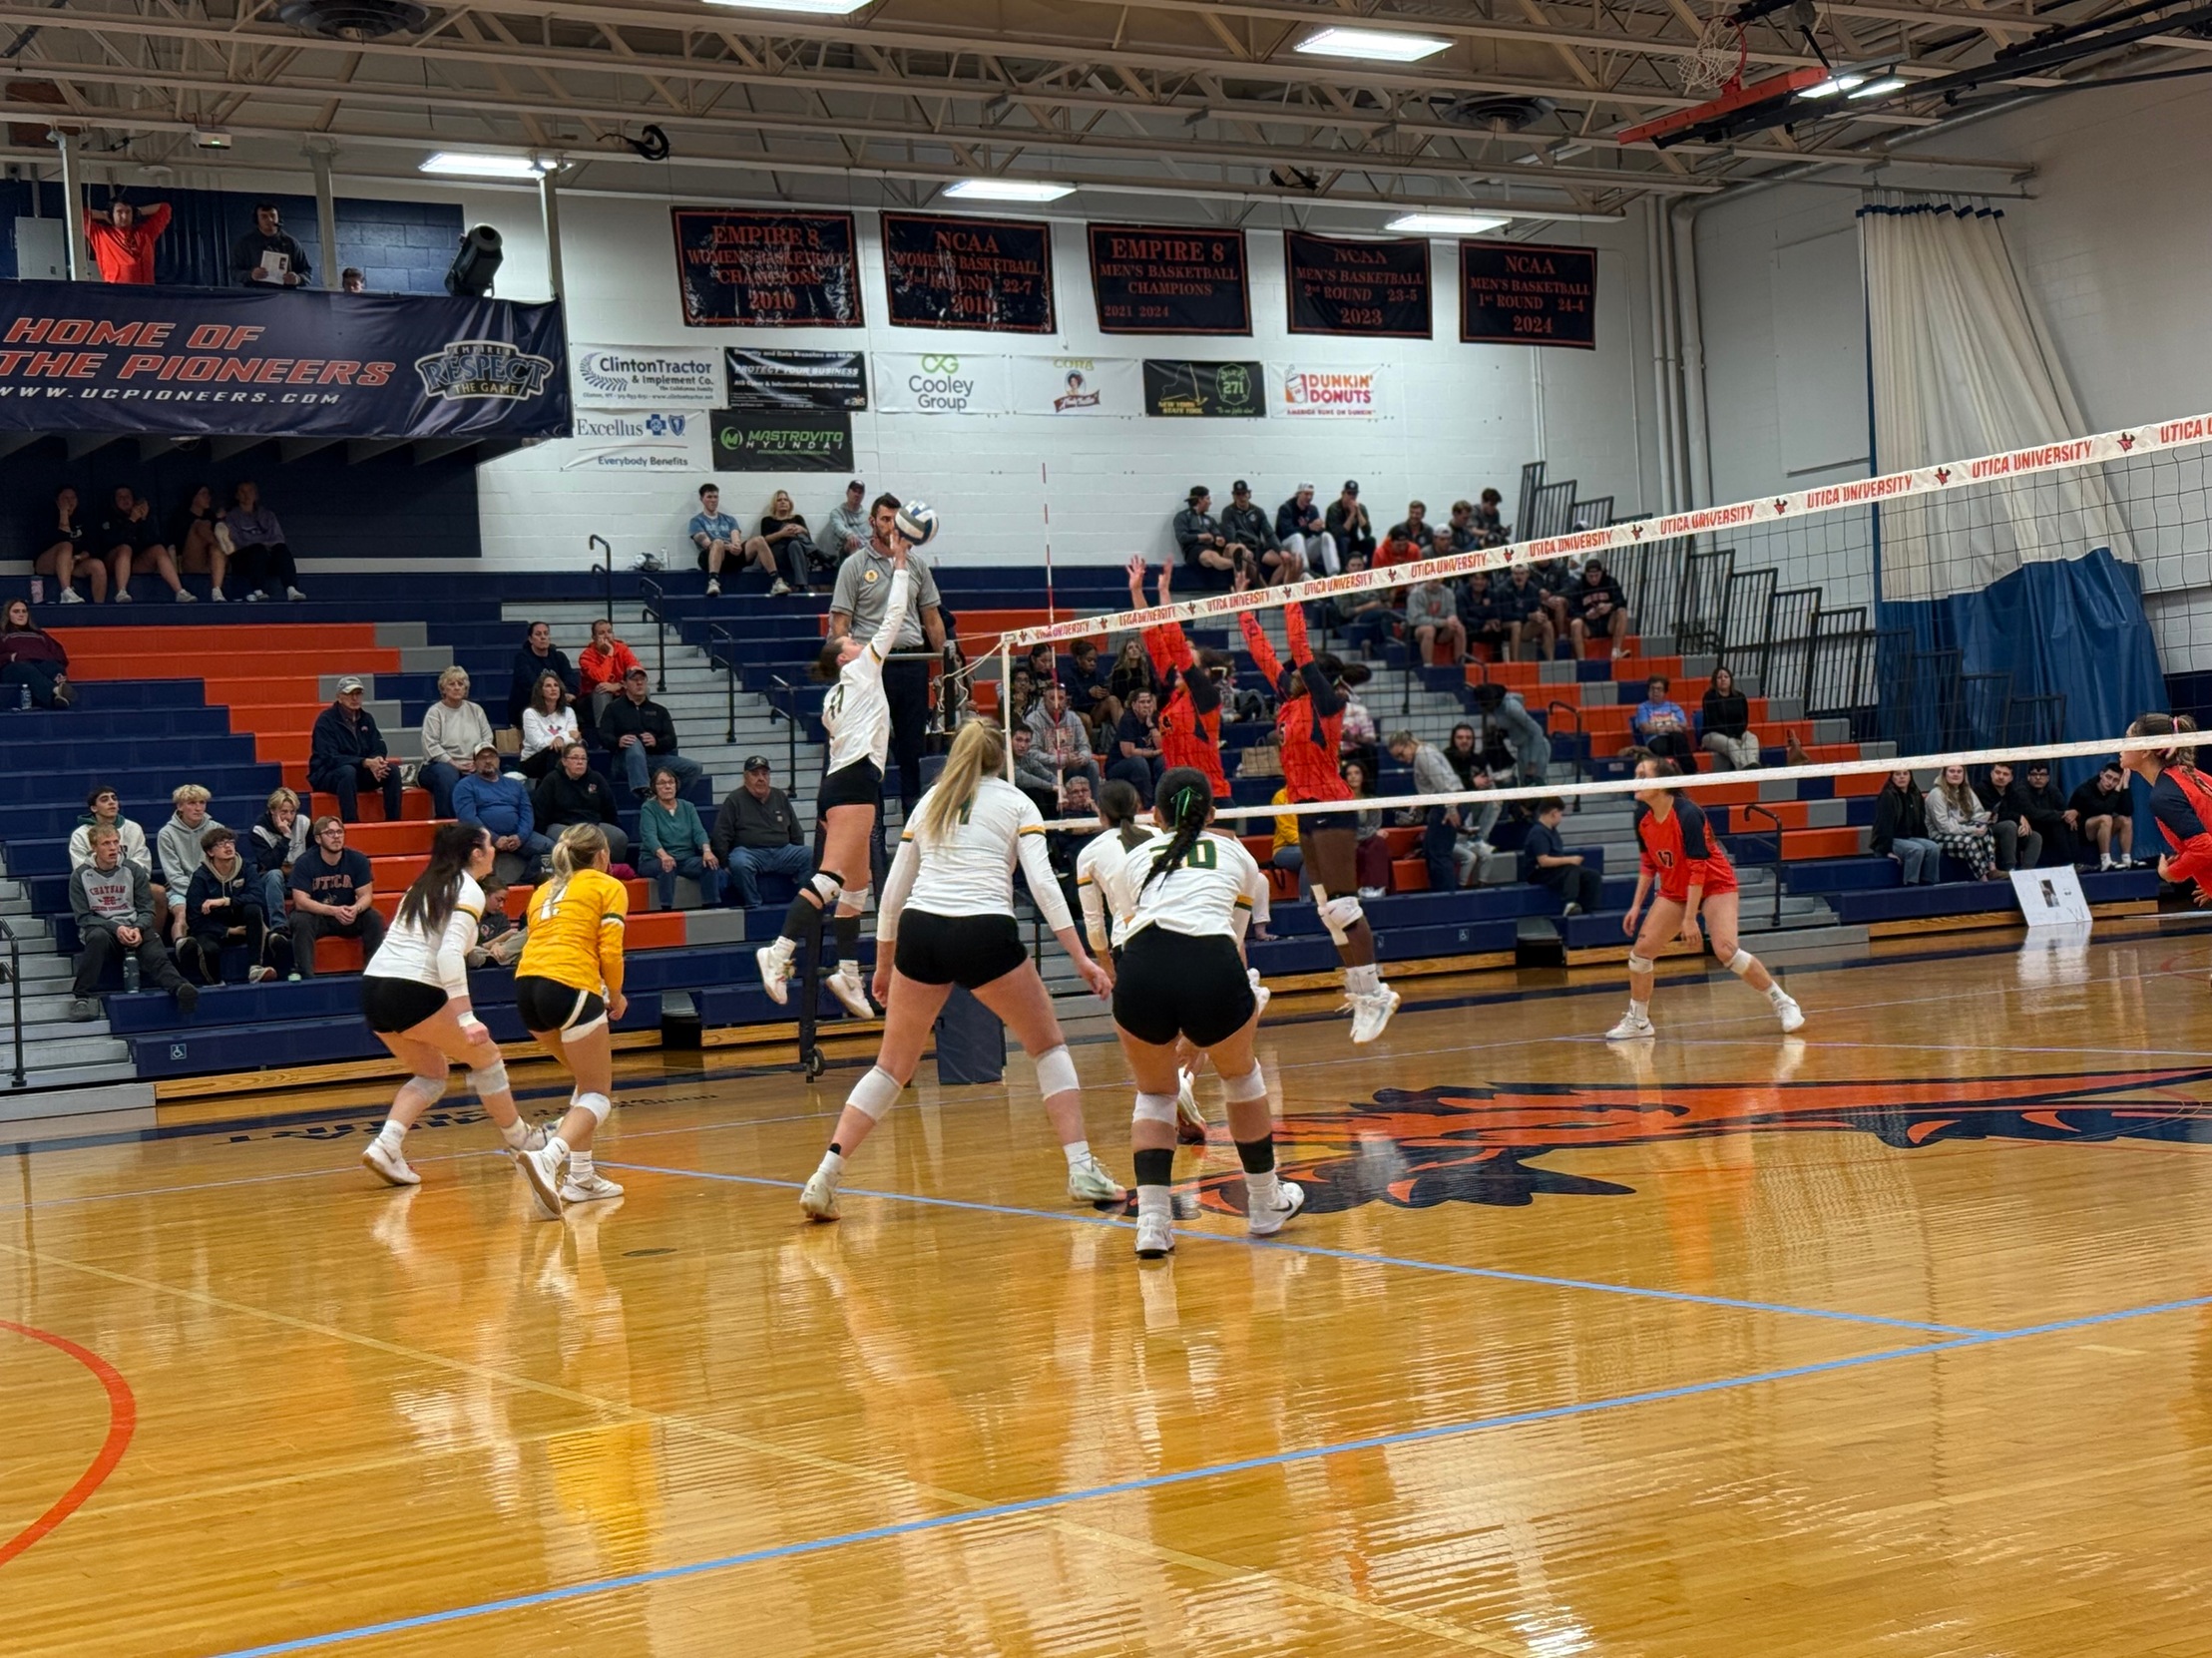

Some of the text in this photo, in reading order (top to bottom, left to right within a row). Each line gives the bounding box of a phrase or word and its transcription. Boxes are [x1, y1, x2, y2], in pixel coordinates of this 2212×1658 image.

[712, 225, 820, 245] EMPIRE 8
[935, 231, 1000, 253] NCAA
[1111, 238, 1224, 262] EMPIRE 8
[1335, 248, 1387, 264] NCAA
[960, 256, 1041, 275] BASKETBALL
[1101, 264, 1237, 279] MEN'S BASKETBALL
[1505, 255, 1555, 274] NCAA
[718, 269, 822, 285] CHAMPIONS
[930, 274, 992, 290] ROUND
[1003, 279, 1032, 294] 22-7
[1296, 267, 1423, 285] MEN'S BASKETBALL
[1128, 281, 1212, 295] CHAMPIONS
[1324, 285, 1372, 301] ROUND
[1387, 288, 1417, 301] 23-5
[1471, 277, 1590, 295] MEN'S BASKETBALL
[749, 291, 796, 309] 2010
[1497, 294, 1543, 309] ROUND
[1557, 299, 1584, 311] 24-4
[1105, 305, 1169, 317] 2021 2024
[1341, 307, 1383, 325] 2023
[3, 317, 265, 349] HOME OF
[1513, 315, 1552, 333] 2024
[0, 351, 396, 386] THE PIONEERS
[421, 355, 548, 391] RESPECT
[600, 356, 712, 373] ClintonTractor
[734, 365, 779, 375] PROTECT
[812, 367, 859, 376] BUSINESS
[454, 382, 517, 395] THE GAME
[633, 375, 714, 387] & Implement Co.
[909, 375, 974, 397] Cooley
[1222, 381, 1244, 395] 271
[1309, 374, 1373, 387] DUNKIN'
[918, 393, 968, 411] Group
[1310, 389, 1371, 403] DONUTS
[577, 419, 644, 436] Excellus
[748, 430, 844, 443] MASTROVITO
[2161, 421, 2203, 445] UTICA
[599, 456, 688, 467] Everybody Benefits
[1973, 440, 2093, 479] UTICA UNIVERSITY
[1807, 475, 1913, 509] UTICA UNIVERSITY
[1660, 505, 1754, 535] UTICA UNIVERSITY
[1529, 530, 1612, 558] UTICA UNIVERSITY
[1411, 553, 1487, 579] UTICA UNIVERSITY
[1304, 581, 1327, 597] UTICA
[1658, 851, 1672, 868] 17
[312, 874, 353, 892] UTICA
